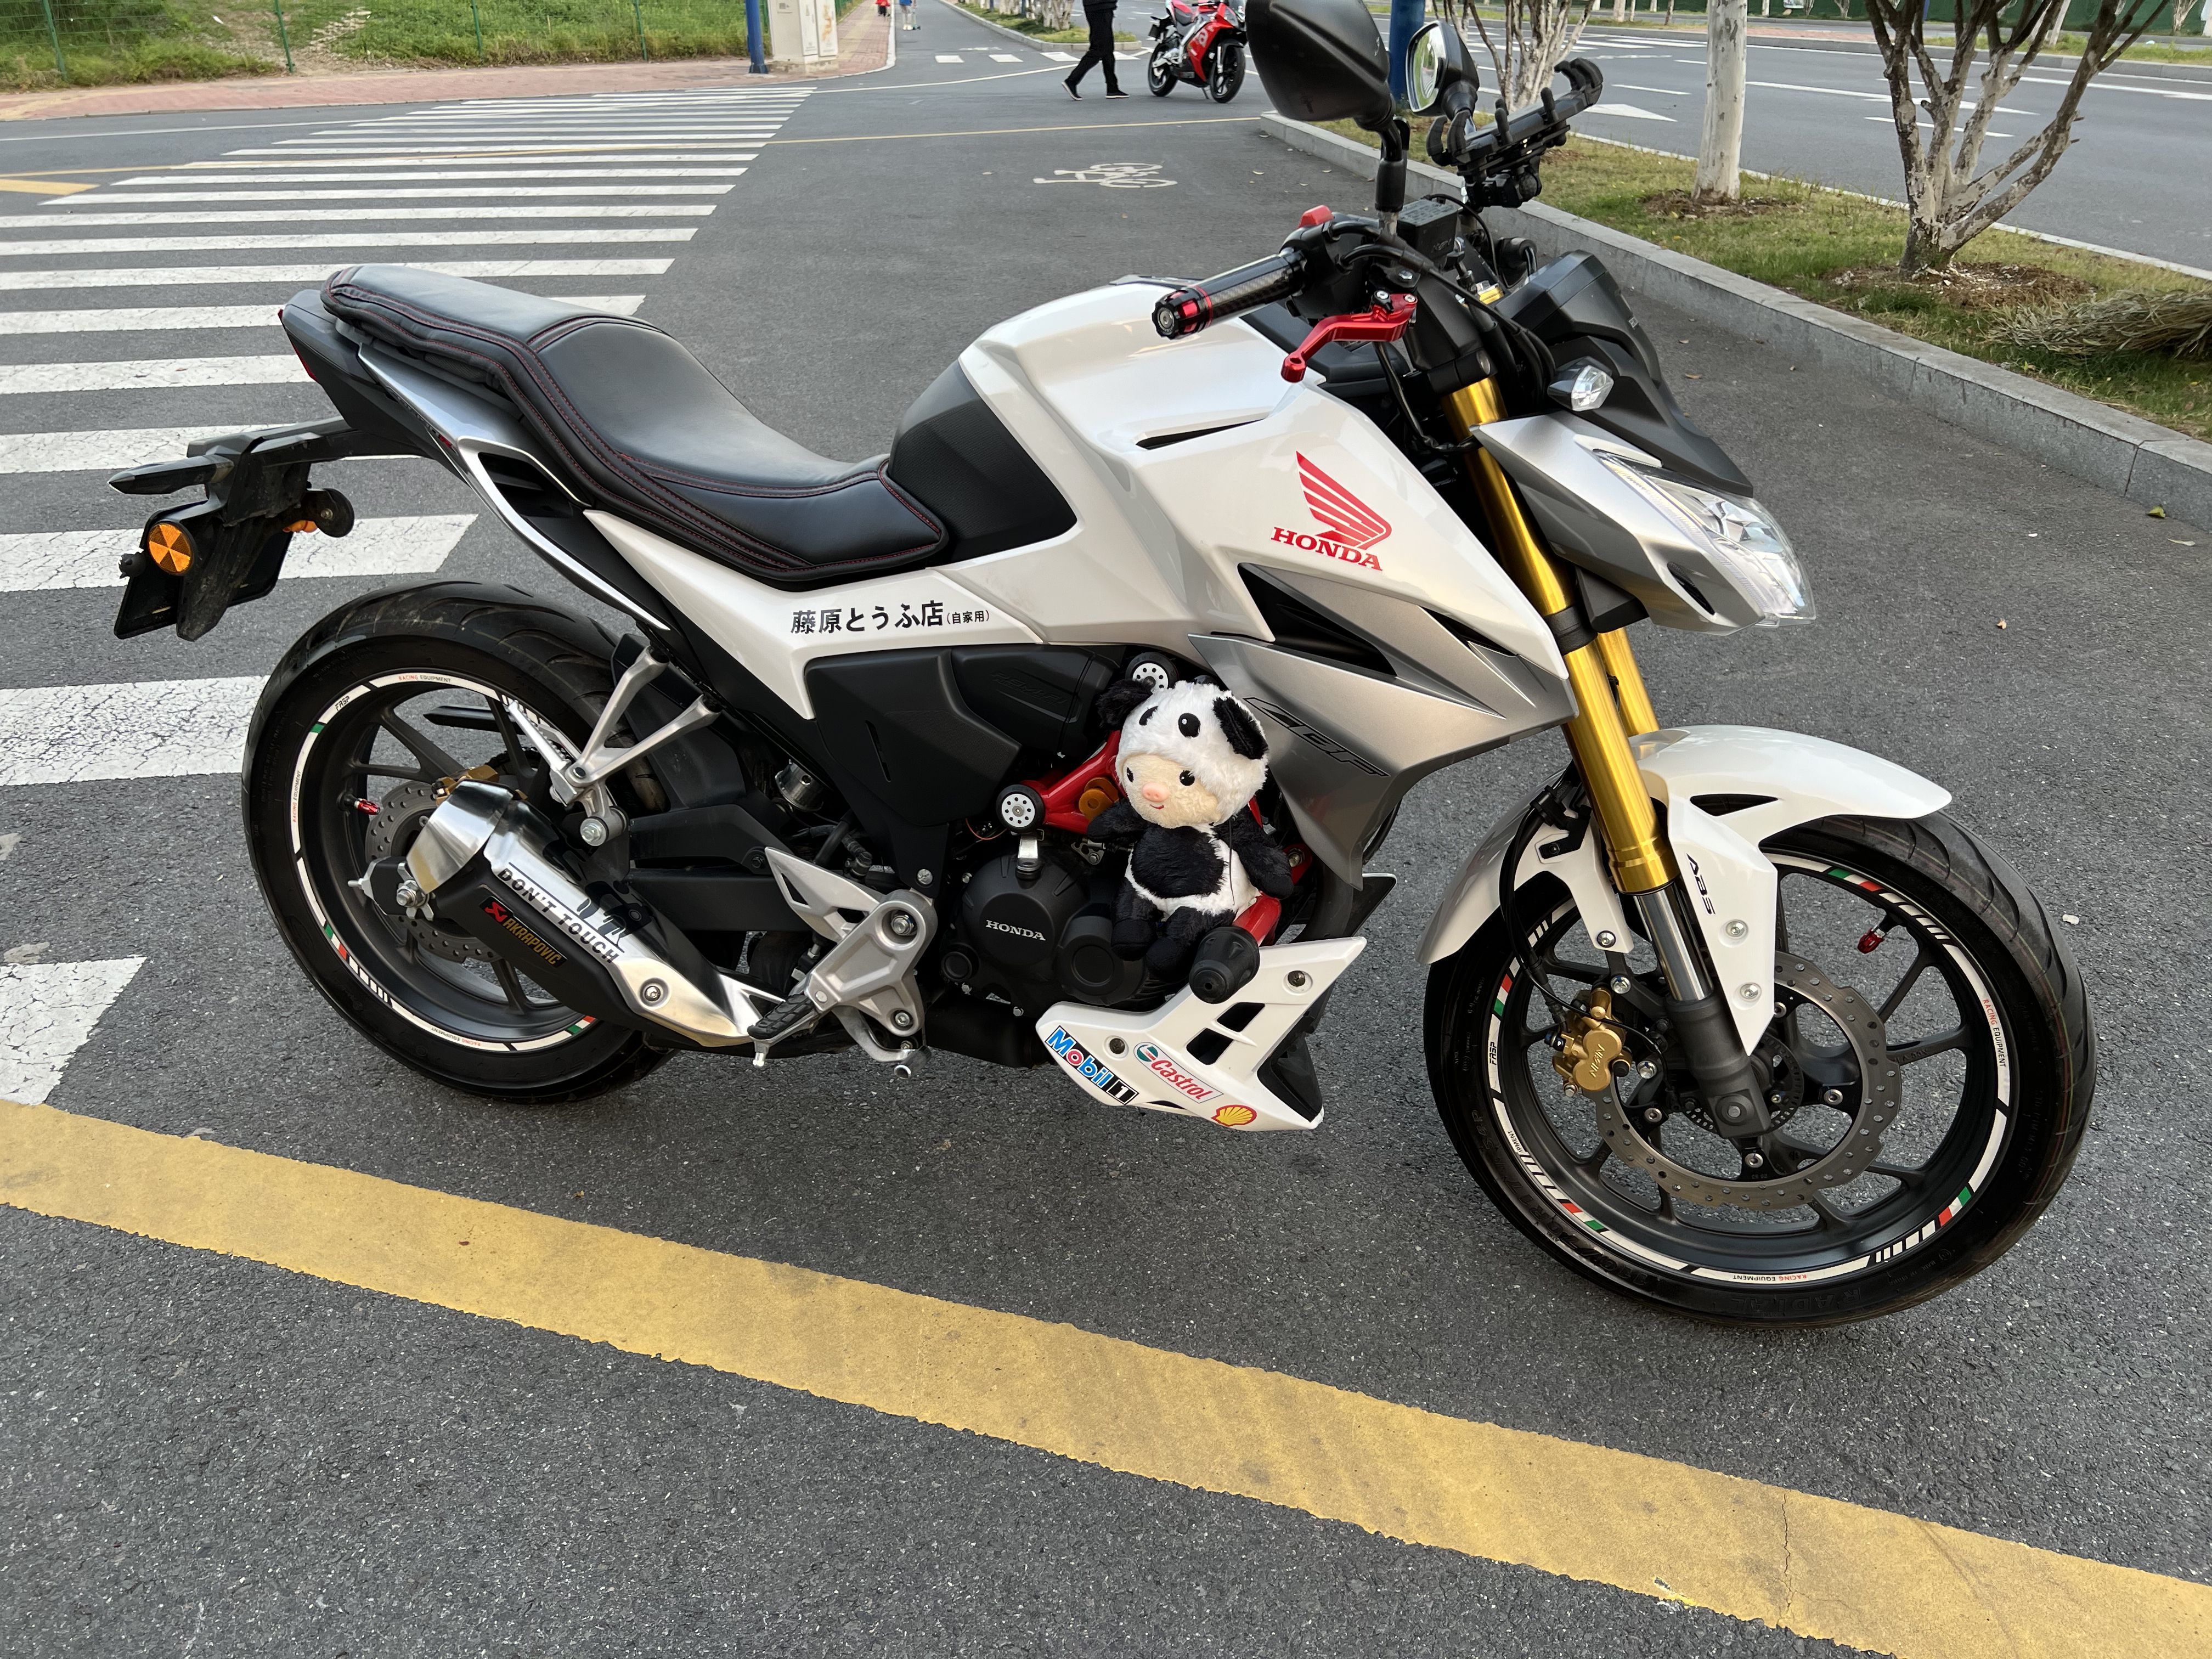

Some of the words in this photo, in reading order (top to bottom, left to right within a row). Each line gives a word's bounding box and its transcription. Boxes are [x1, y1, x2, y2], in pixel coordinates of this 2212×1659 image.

[1271, 527, 1383, 571] HONDA
[293, 770, 301, 801] EQUIPMENT
[1686, 853, 1716, 915] ABS
[498, 867, 557, 913] DON'T
[558, 913, 619, 963] TOUCH
[985, 919, 1046, 941] HONDA
[503, 918, 562, 966] AKRAPOVIC
[431, 1027, 460, 1041] EQUIPMENT
[462, 1038, 481, 1046] RACING
[1983, 999, 1997, 1025] RACING
[1993, 1027, 2006, 1067] EQUIPMENT
[1047, 1027, 1113, 1087] Mobil
[1151, 1059, 1213, 1100] Castrol
